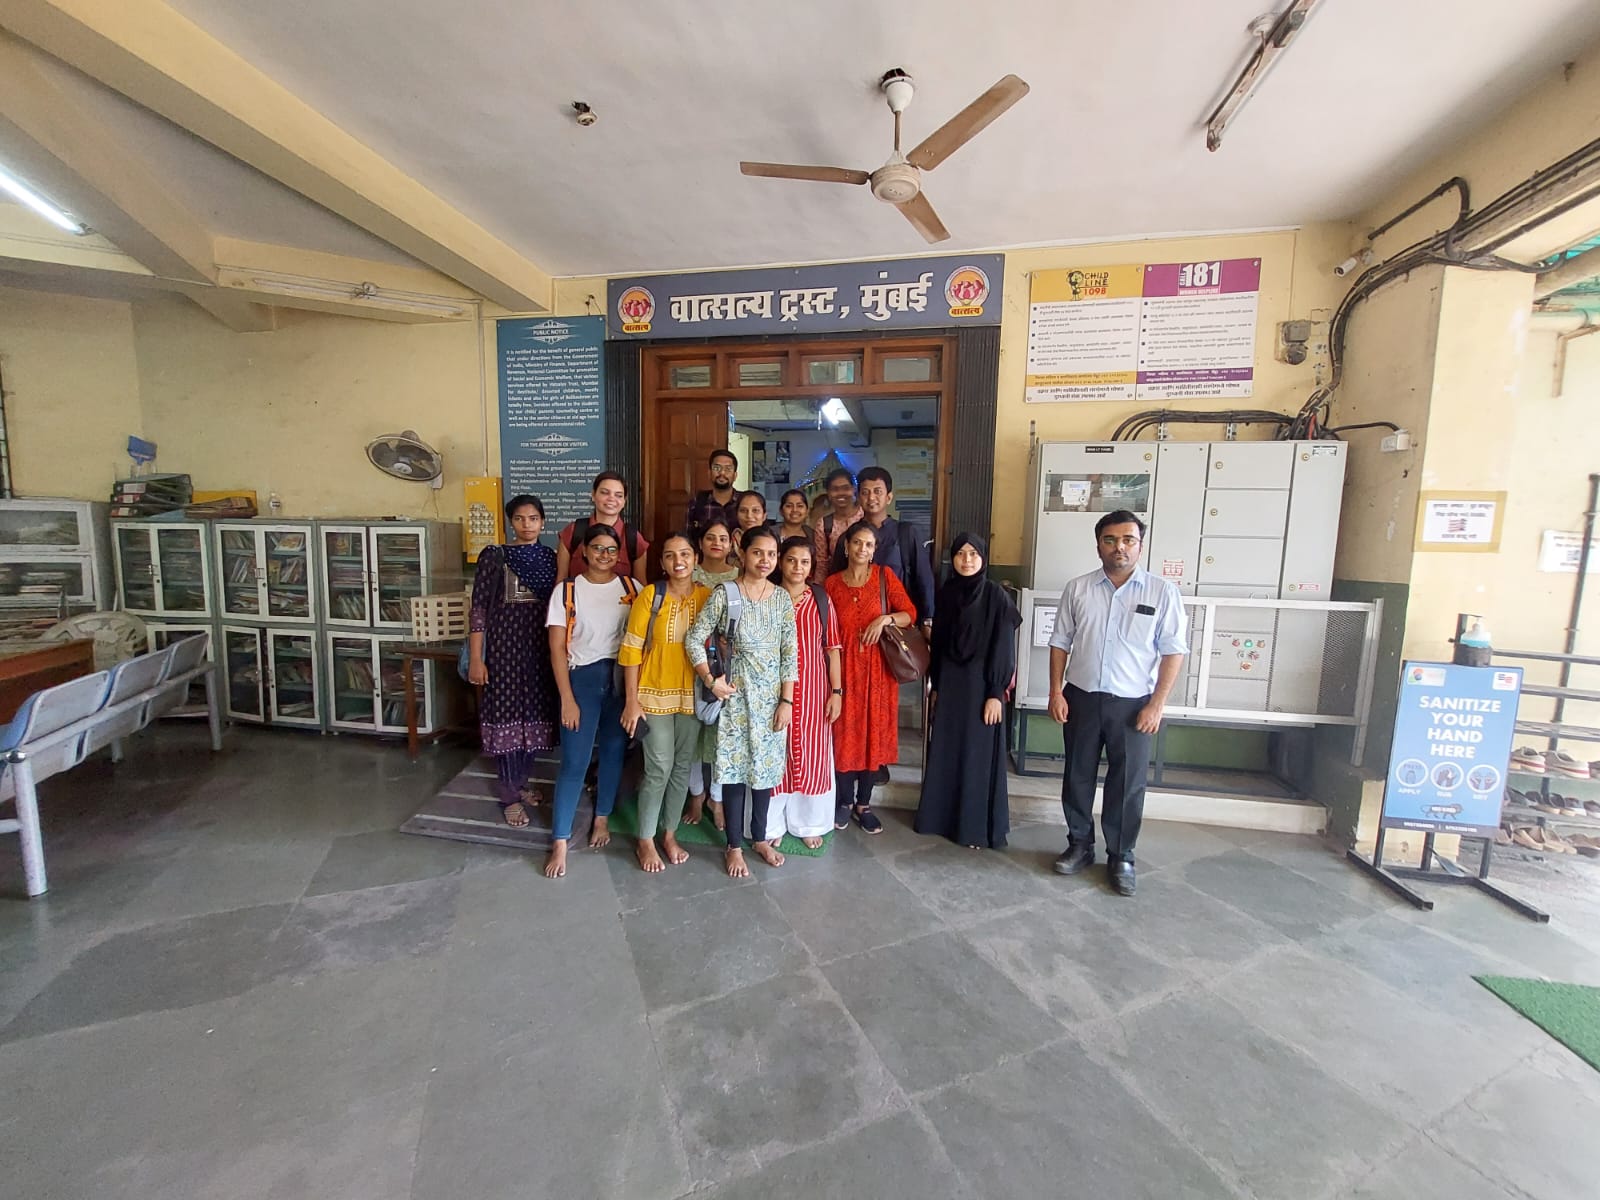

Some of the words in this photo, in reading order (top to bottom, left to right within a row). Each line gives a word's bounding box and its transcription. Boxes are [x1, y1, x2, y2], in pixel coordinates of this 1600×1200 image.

[1084, 271, 1109, 280] CHILD
[1183, 262, 1220, 287] 181
[669, 290, 774, 323] वात्सल्य
[859, 271, 934, 321] मुंबई
[1084, 287, 1106, 296] 1098
[1419, 696, 1502, 713] SANITIZE
[1432, 712, 1483, 728] YOUR
[1427, 728, 1483, 742] HAND
[1430, 744, 1476, 758] HERE
